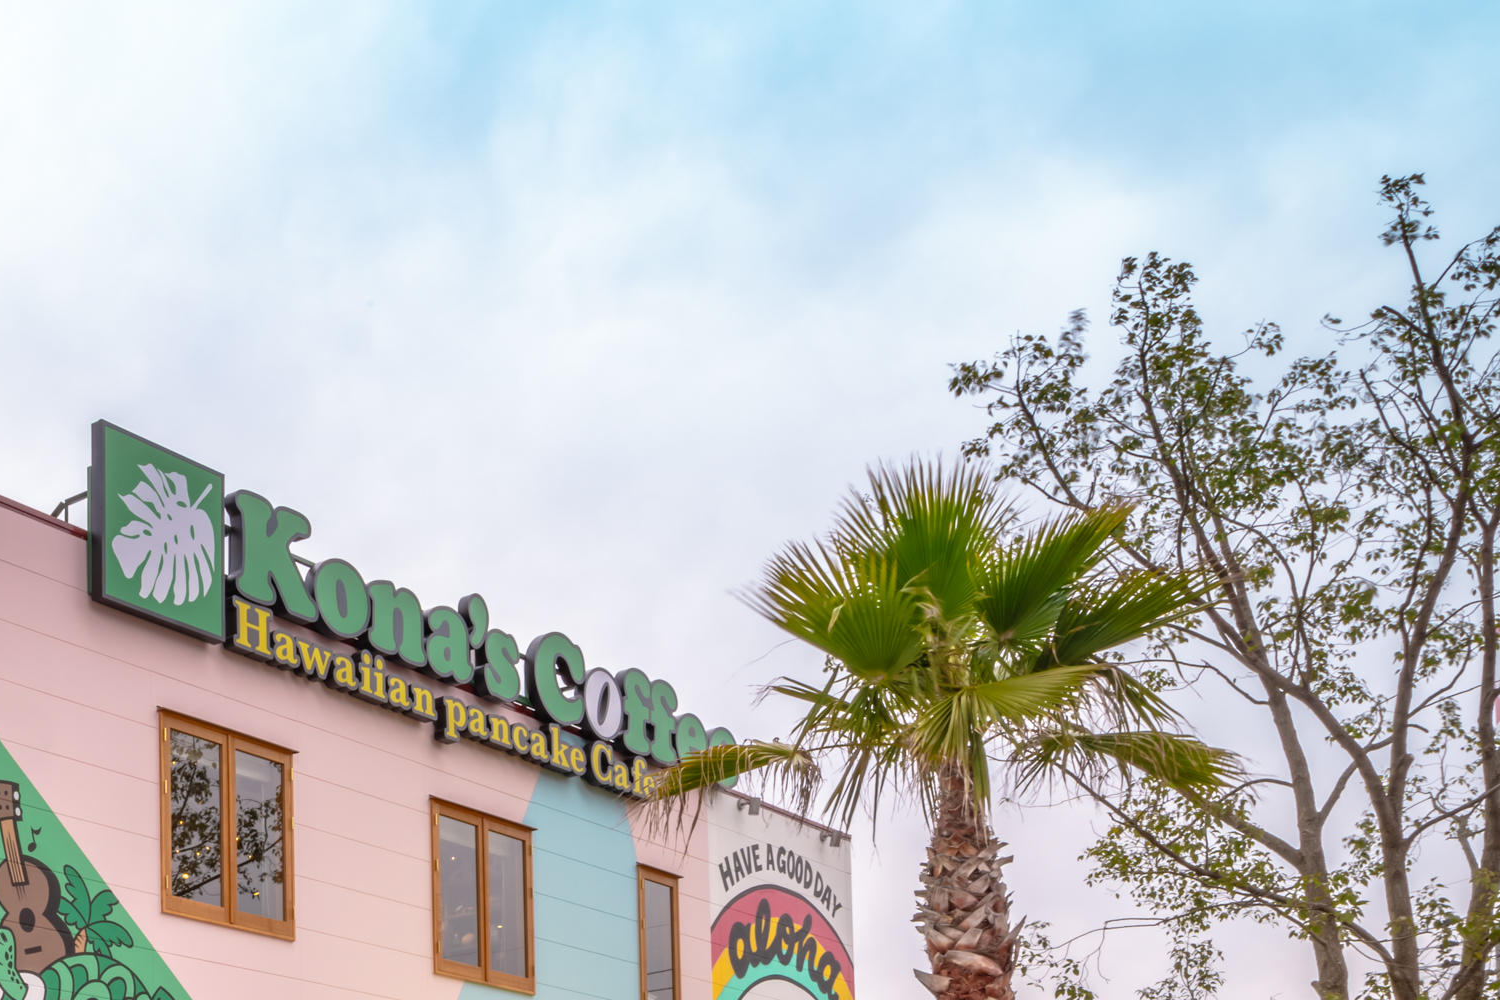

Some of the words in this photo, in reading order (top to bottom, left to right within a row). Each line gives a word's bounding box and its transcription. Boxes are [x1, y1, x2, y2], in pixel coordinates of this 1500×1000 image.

[227, 489, 521, 702] Kona's
[233, 596, 438, 722] Hawaiian
[443, 695, 587, 776] pancake
[718, 843, 763, 893] HAVE
[766, 843, 776, 871] A
[776, 846, 813, 890] GOOD
[813, 870, 843, 919] DAY
